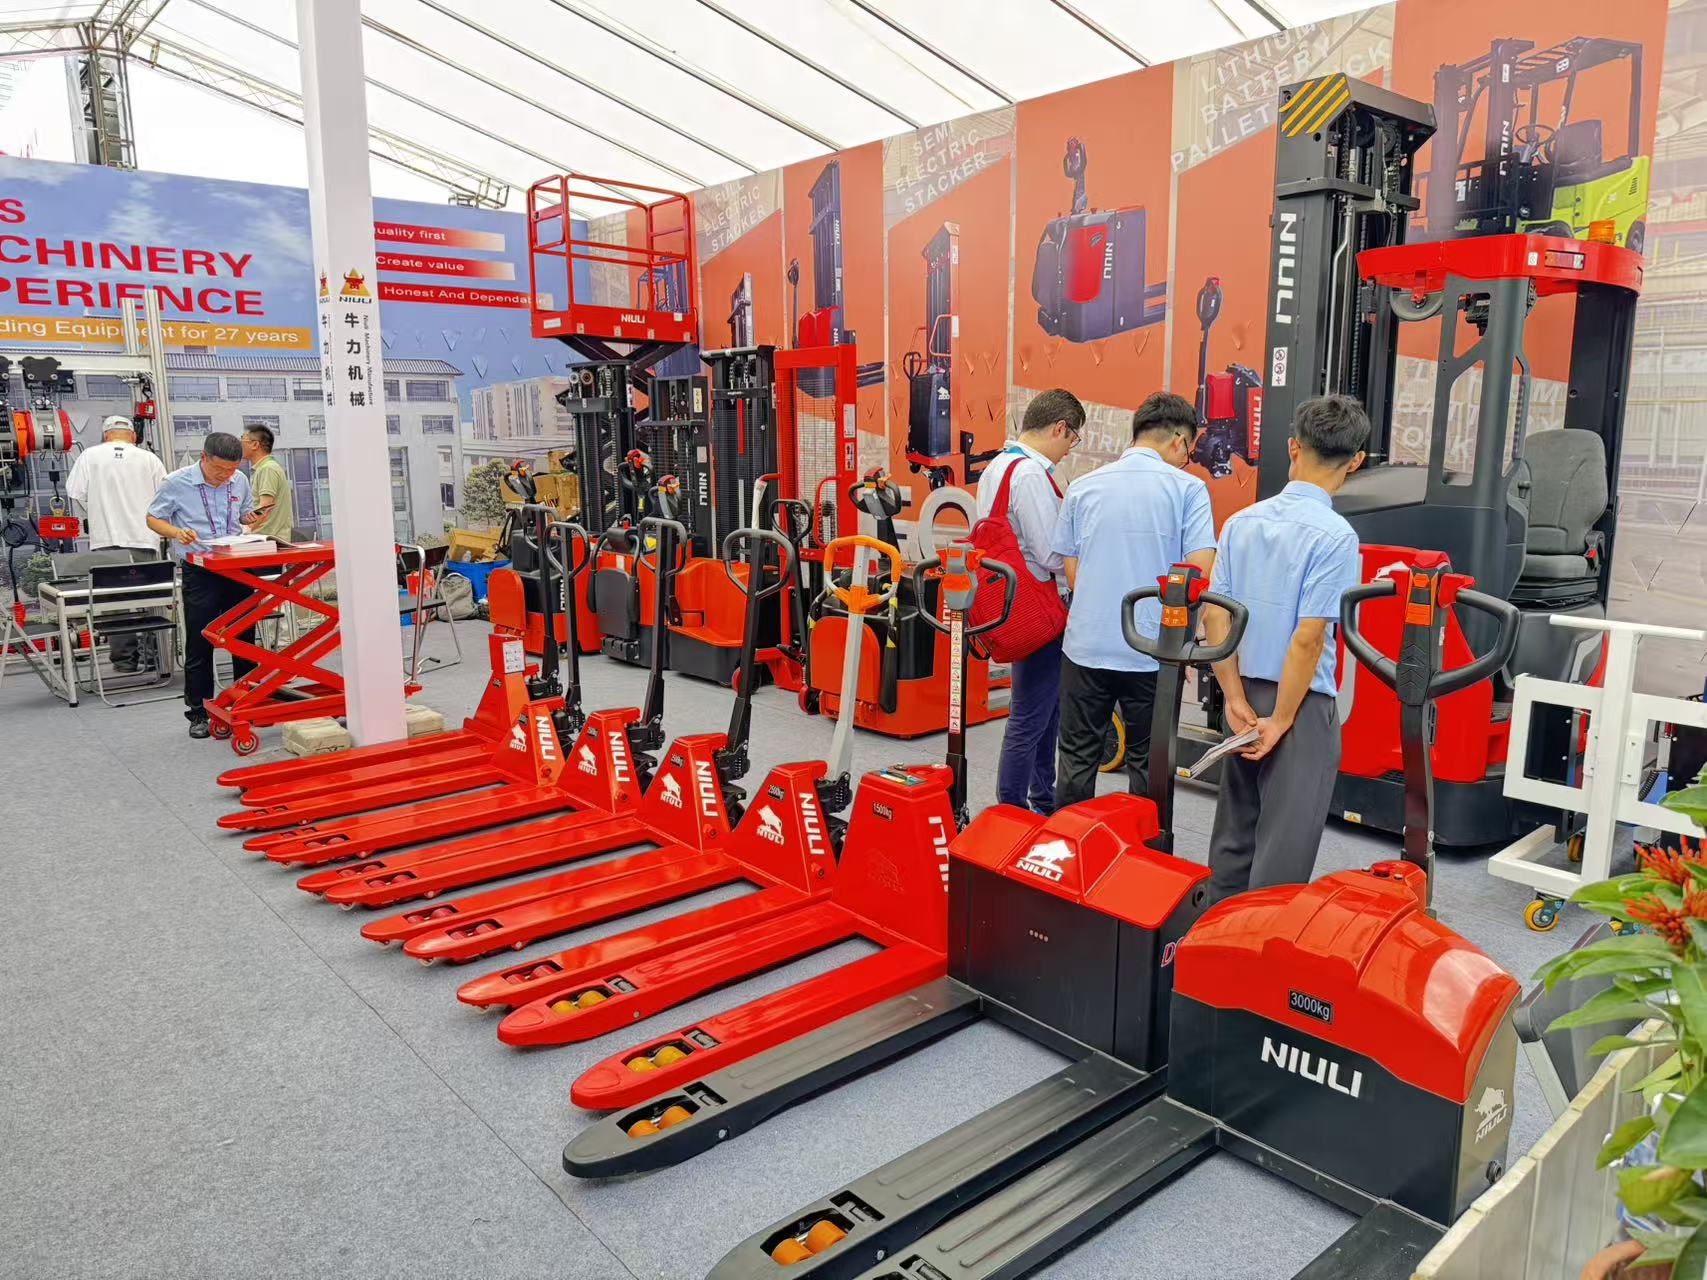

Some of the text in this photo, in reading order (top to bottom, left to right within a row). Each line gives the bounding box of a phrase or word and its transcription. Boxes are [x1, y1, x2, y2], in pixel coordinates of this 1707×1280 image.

[912, 120, 955, 157] SEMI
[1171, 102, 1272, 174] PALLET
[895, 129, 980, 195] ELECTRIC
[904, 151, 987, 213] STACKER
[705, 185, 760, 237] ELECTRIC
[711, 204, 767, 252] STACKER
[420, 230, 446, 240] first
[376, 255, 465, 271] Create value
[1103, 241, 1114, 280] NIULI
[1275, 211, 1298, 325] NIULI
[384, 286, 434, 298] Honest
[438, 290, 465, 300] And
[181, 325, 208, 339] for
[214, 328, 240, 340] 27
[246, 330, 299, 344] years
[620, 313, 646, 324] NIULI
[344, 312, 365, 407] 牛力机械
[698, 472, 708, 506] NIULI
[535, 715, 557, 761] NIULI
[608, 731, 630, 782] NIULI
[695, 760, 719, 818] NIULI
[799, 792, 825, 855] NIULI
[1015, 858, 1064, 882] NIULI
[1290, 992, 1331, 1020] 3000kg
[1260, 1035, 1363, 1098] NIULI
[1474, 1107, 1507, 1145] NIULI
